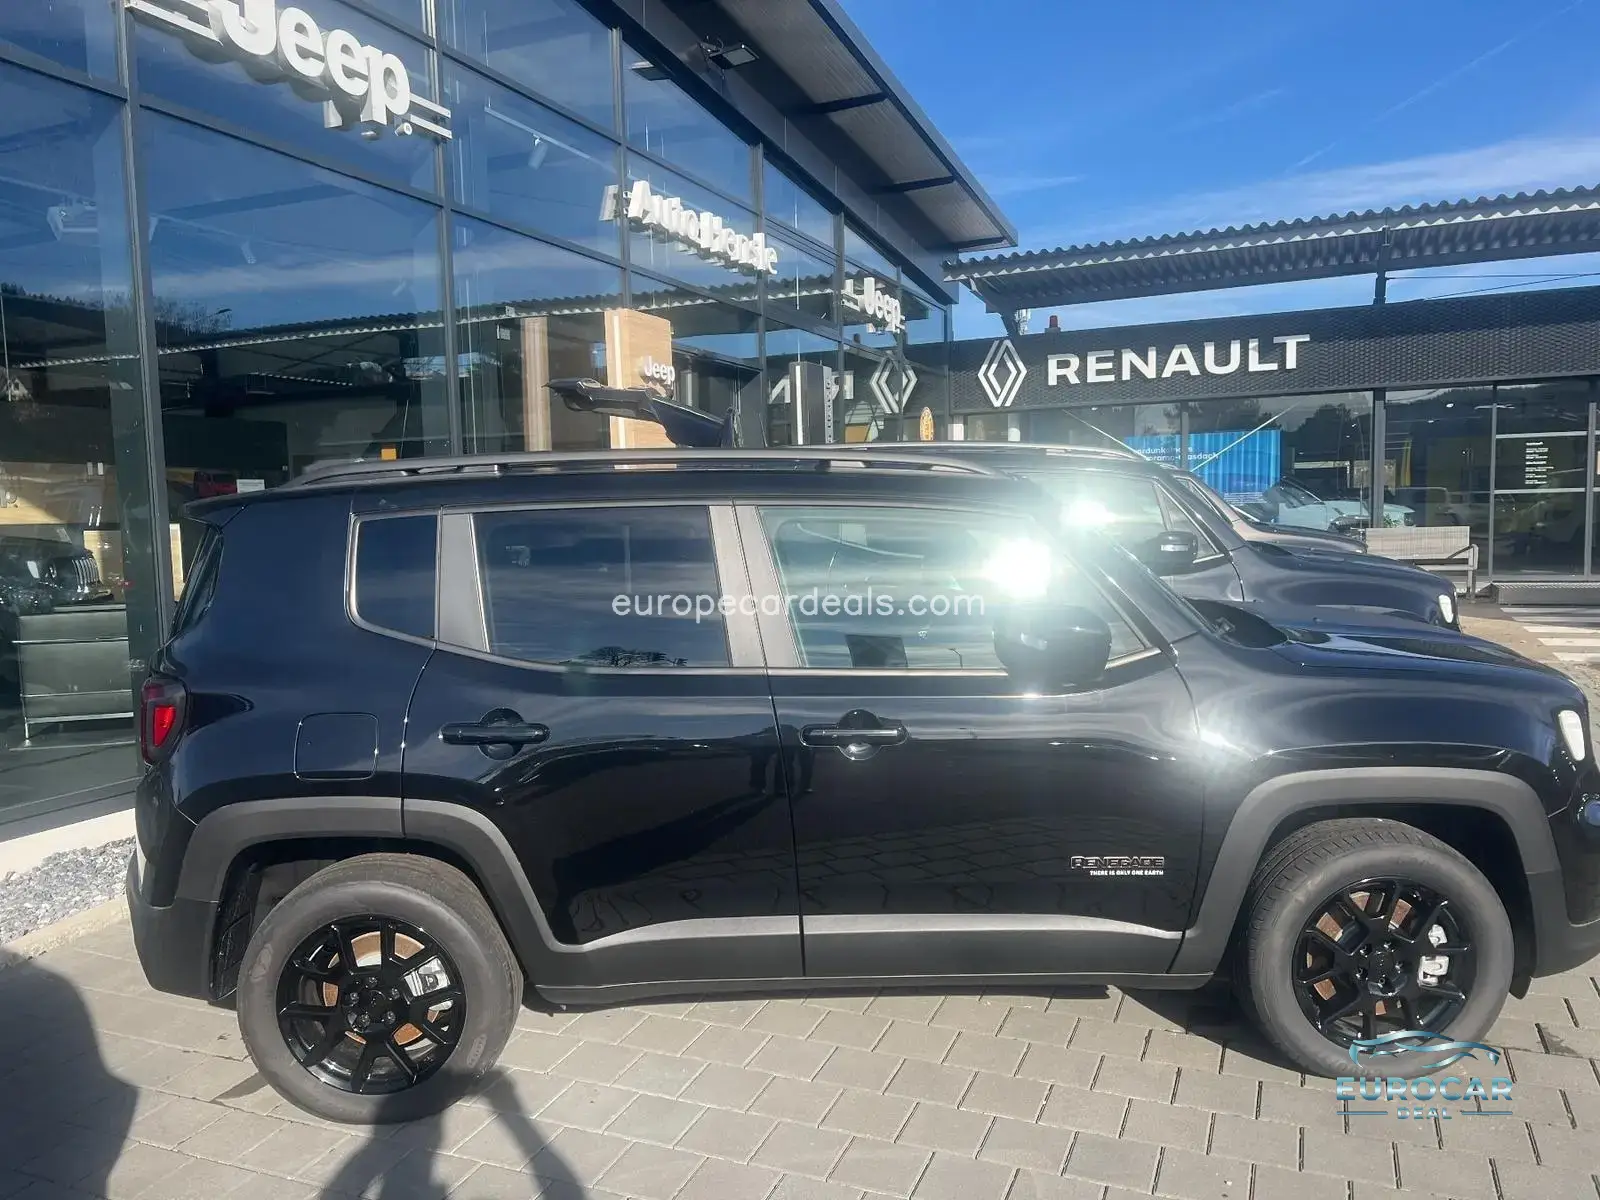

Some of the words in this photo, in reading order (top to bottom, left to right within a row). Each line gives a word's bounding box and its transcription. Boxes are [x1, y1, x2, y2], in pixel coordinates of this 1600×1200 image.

[218, 0, 411, 126] Jeep
[858, 276, 902, 334] Jeep
[643, 355, 676, 386] Jeep
[1047, 333, 1311, 386] RENAULT
[1070, 855, 1165, 869] RENEGADE
